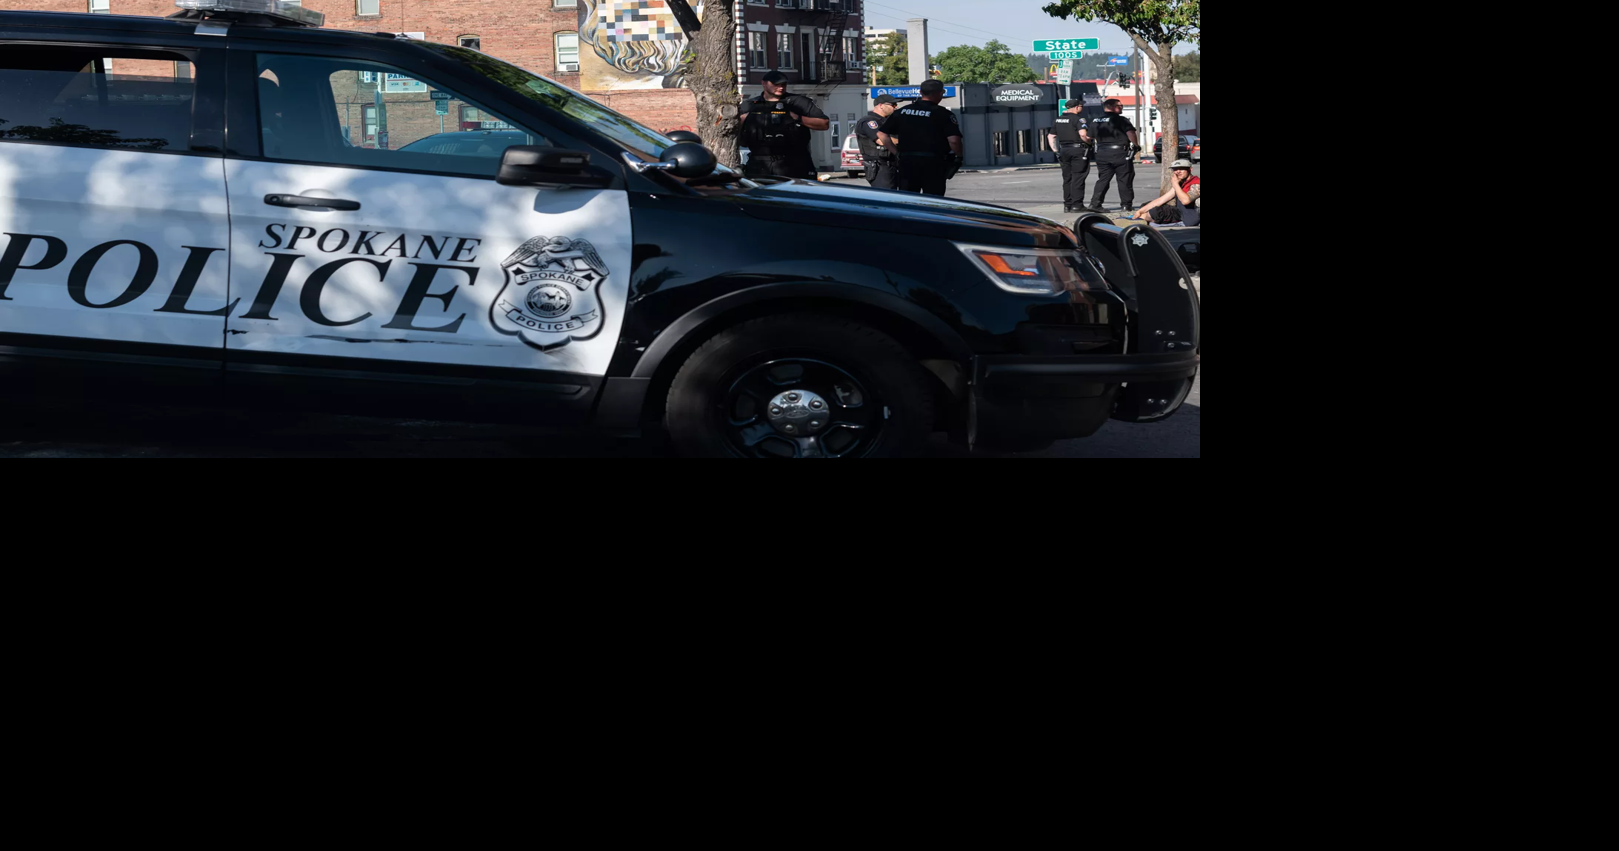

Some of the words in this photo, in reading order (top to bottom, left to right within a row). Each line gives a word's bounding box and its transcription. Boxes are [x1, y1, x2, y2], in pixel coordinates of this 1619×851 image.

[1045, 41, 1086, 50] State
[901, 108, 931, 117] POLICE
[258, 223, 482, 263] SPOKANE
[0, 232, 480, 333] POLICE
[520, 270, 583, 286] SPOKANE
[516, 315, 574, 330] POLICE
